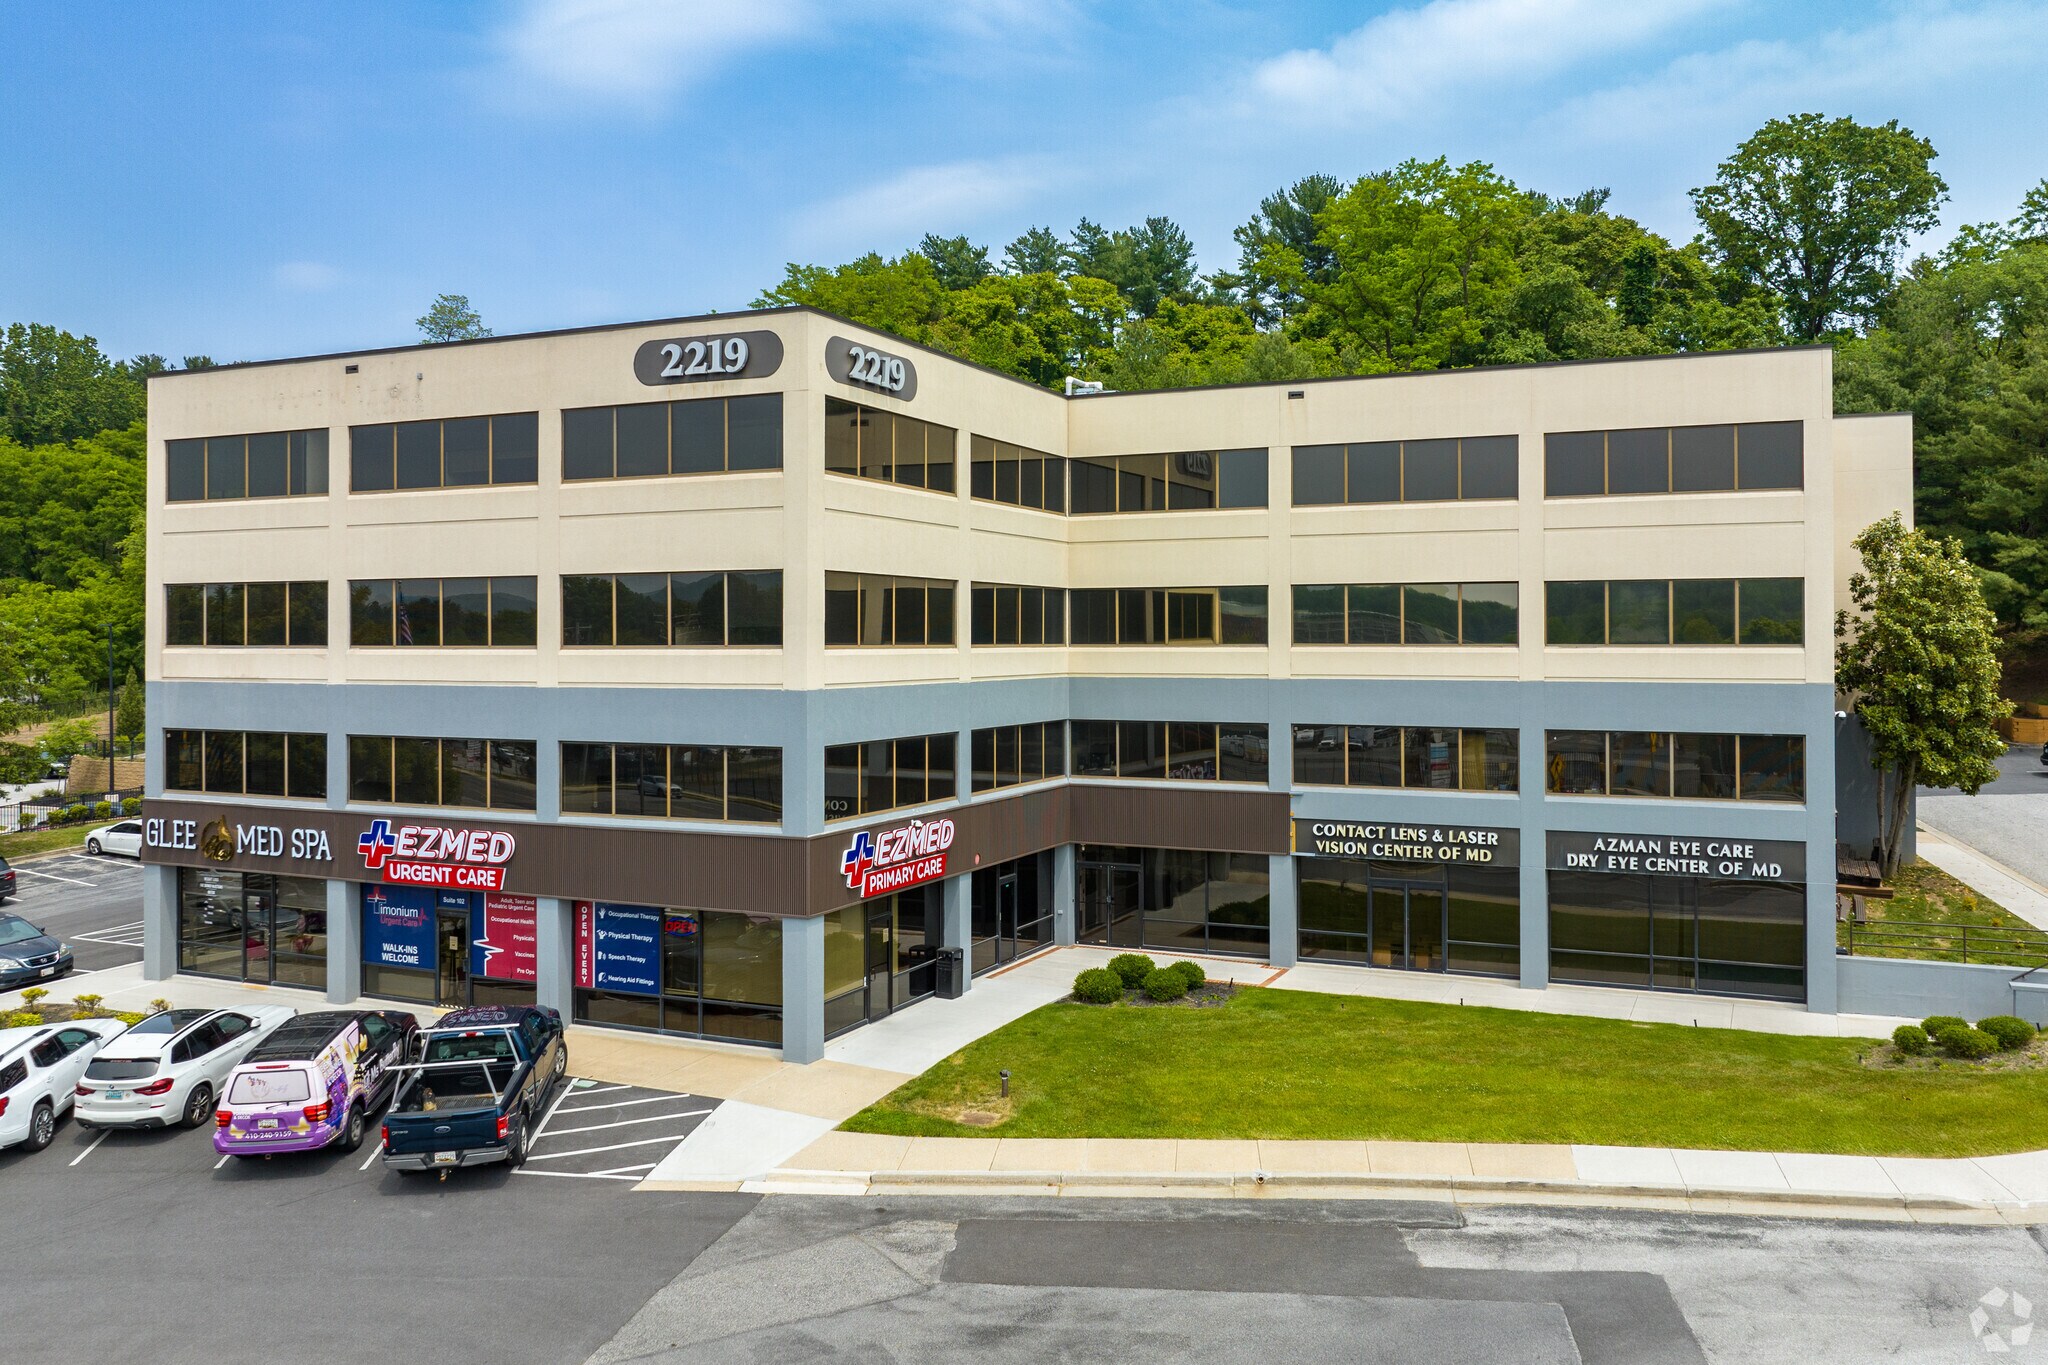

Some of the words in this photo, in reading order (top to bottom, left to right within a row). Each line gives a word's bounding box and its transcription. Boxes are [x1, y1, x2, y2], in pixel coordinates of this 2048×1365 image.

[660, 337, 750, 378] 2219
[848, 346, 906, 392] 2219
[146, 818, 197, 850] GLEE
[236, 824, 284, 857] MED
[291, 828, 333, 861] SPA
[874, 818, 955, 867] EZMED
[1312, 823, 1386, 840] CONTACT
[1390, 827, 1428, 842] LENS
[1431, 829, 1444, 843] &
[1448, 830, 1499, 846] LASER
[397, 825, 516, 864] EZMED
[1315, 840, 1368, 855] VISION
[1372, 843, 1434, 860] CENTER
[1438, 846, 1462, 860] OF
[1466, 847, 1493, 862] MD
[1593, 838, 1662, 854] AZMAN
[1669, 841, 1701, 856] EYE
[1706, 842, 1754, 859] CARE
[1566, 852, 1600, 868] DRY
[1607, 855, 1639, 871] EYE
[1645, 858, 1710, 875] CENTER
[1718, 861, 1744, 876] OF
[1751, 863, 1782, 878] MD
[390, 862, 453, 884] URGENT
[456, 868, 497, 887] CARE
[869, 864, 916, 893] PRIMARY
[916, 857, 943, 879] CARE
[443, 896, 456, 904] Suite
[380, 916, 402, 926] Urgent
[403, 918, 418, 927] Care
[490, 916, 520, 924] Occupational
[608, 910, 640, 919] Occupational
[640, 913, 660, 922] Therapy
[664, 921, 698, 933] OPEN
[513, 934, 535, 942] Physicals
[608, 931, 631, 940] Physical
[631, 933, 653, 943] Therapy
[382, 942, 418, 955] WALK-INS
[381, 952, 419, 964] WELCOME
[608, 953, 626, 961] Speech
[626, 954, 646, 964] Therapy
[608, 975, 627, 983] Hearing
[636, 977, 655, 987] Fittings
